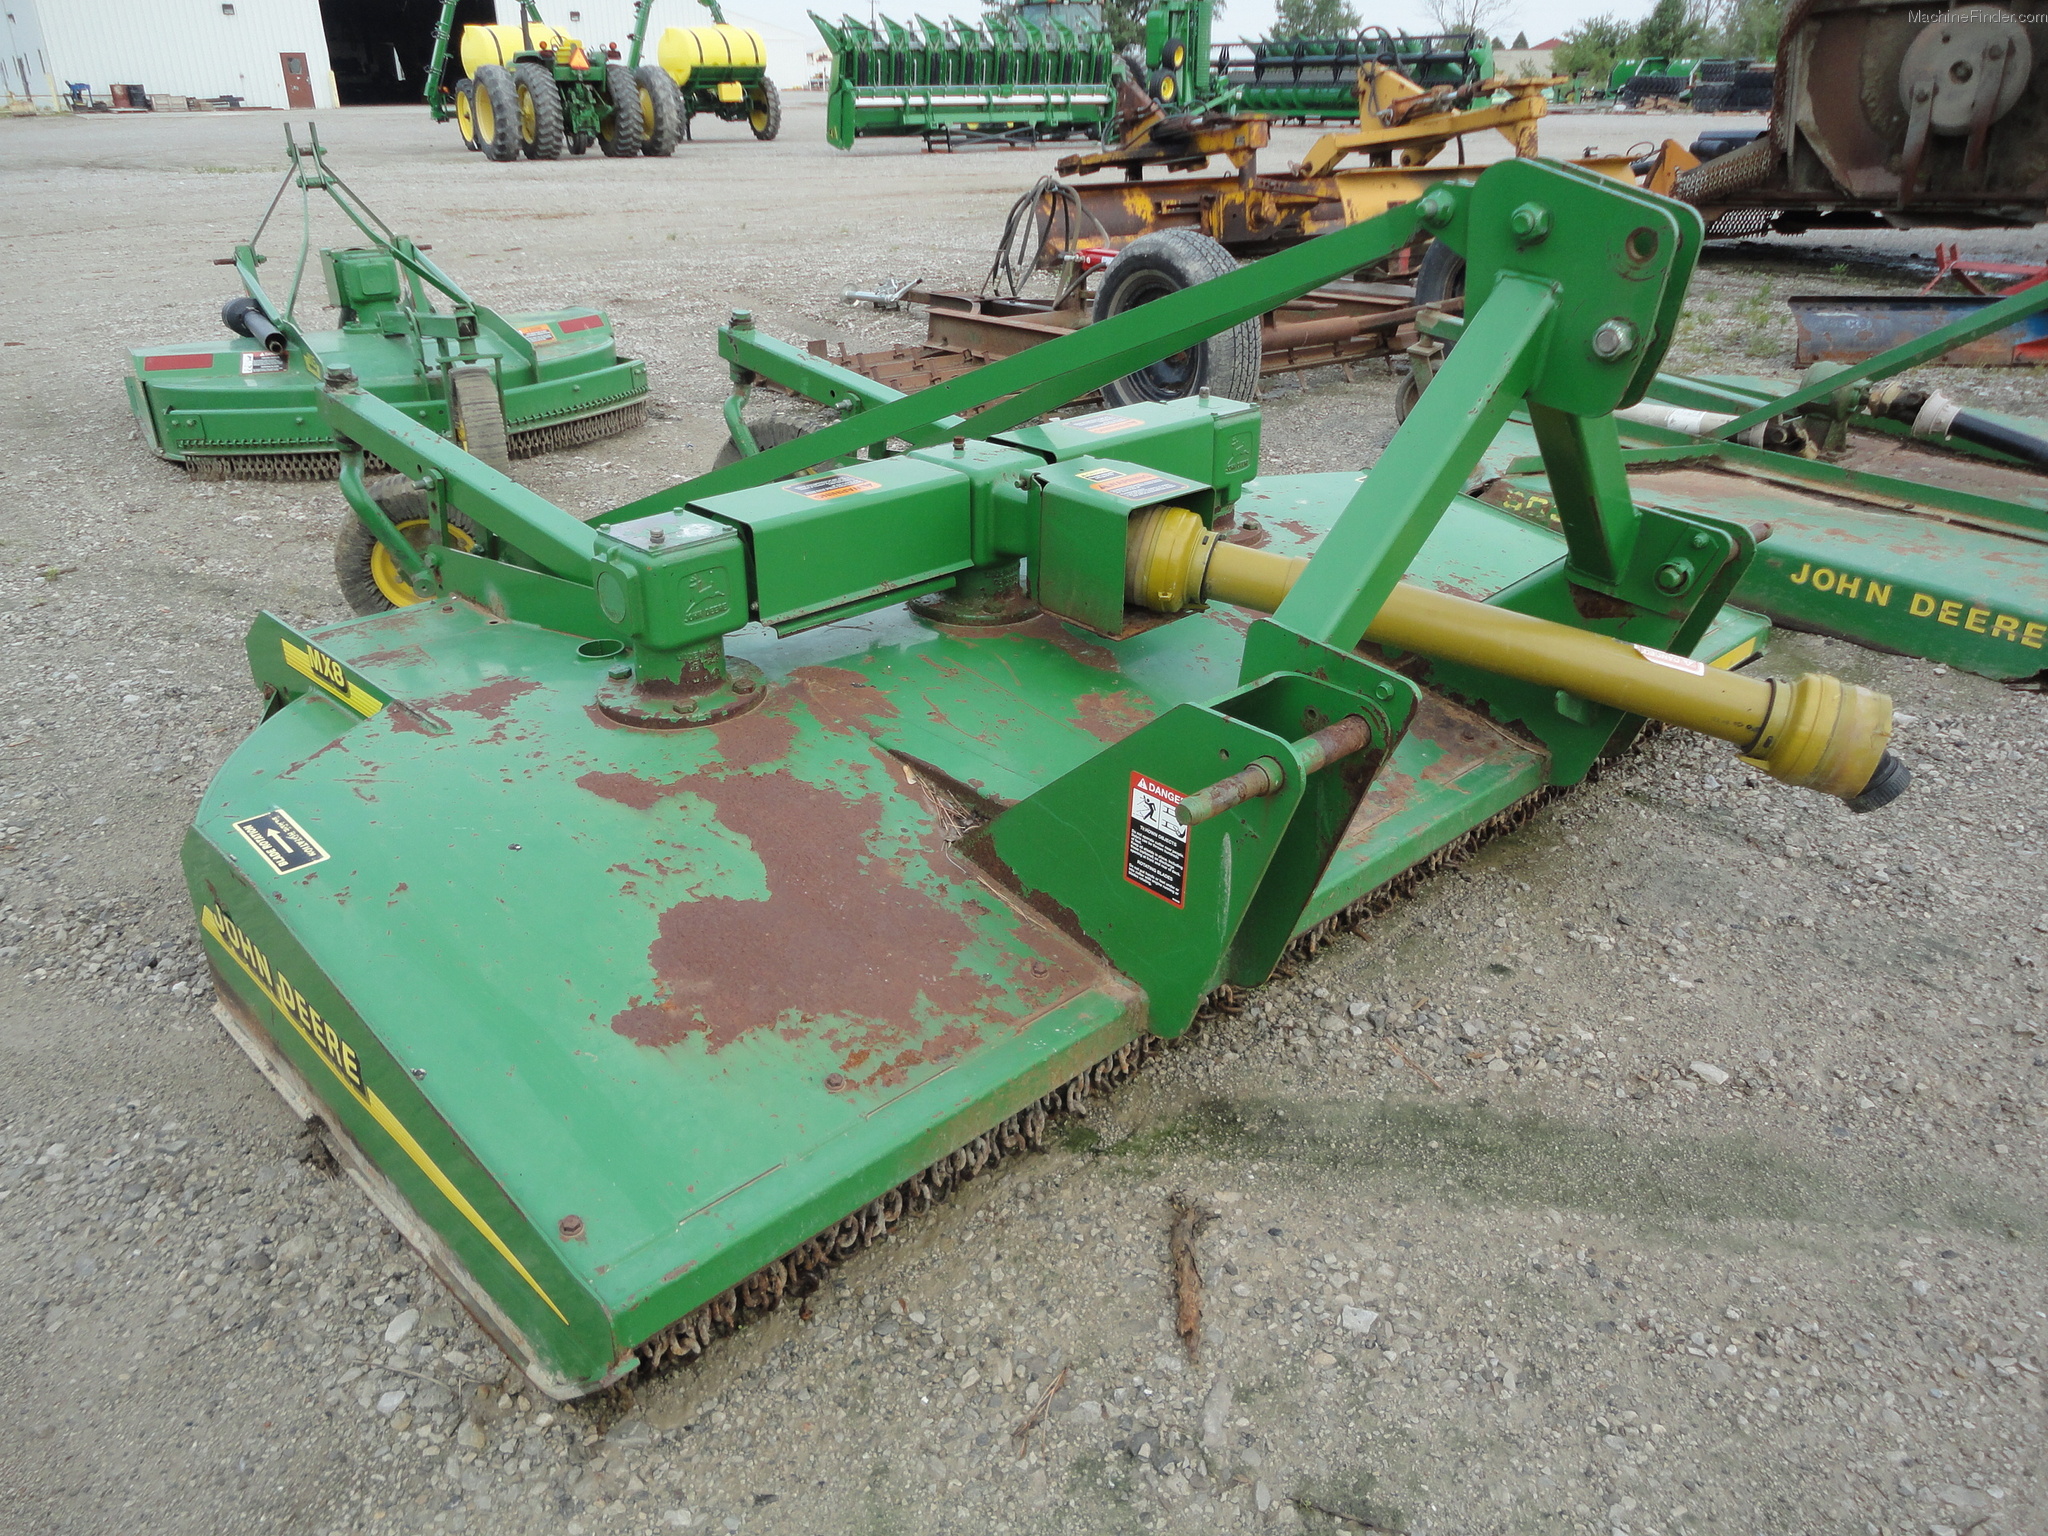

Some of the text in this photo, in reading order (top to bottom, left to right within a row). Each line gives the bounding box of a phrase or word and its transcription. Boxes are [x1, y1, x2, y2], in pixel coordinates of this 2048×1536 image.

[1790, 563, 2047, 649] JOHN DEERE
[306, 644, 345, 688] MX8
[242, 824, 289, 868] BLADE ROTATION
[271, 815, 317, 857] BLADE ROTATION
[212, 903, 361, 1085] JOHN DEERE
